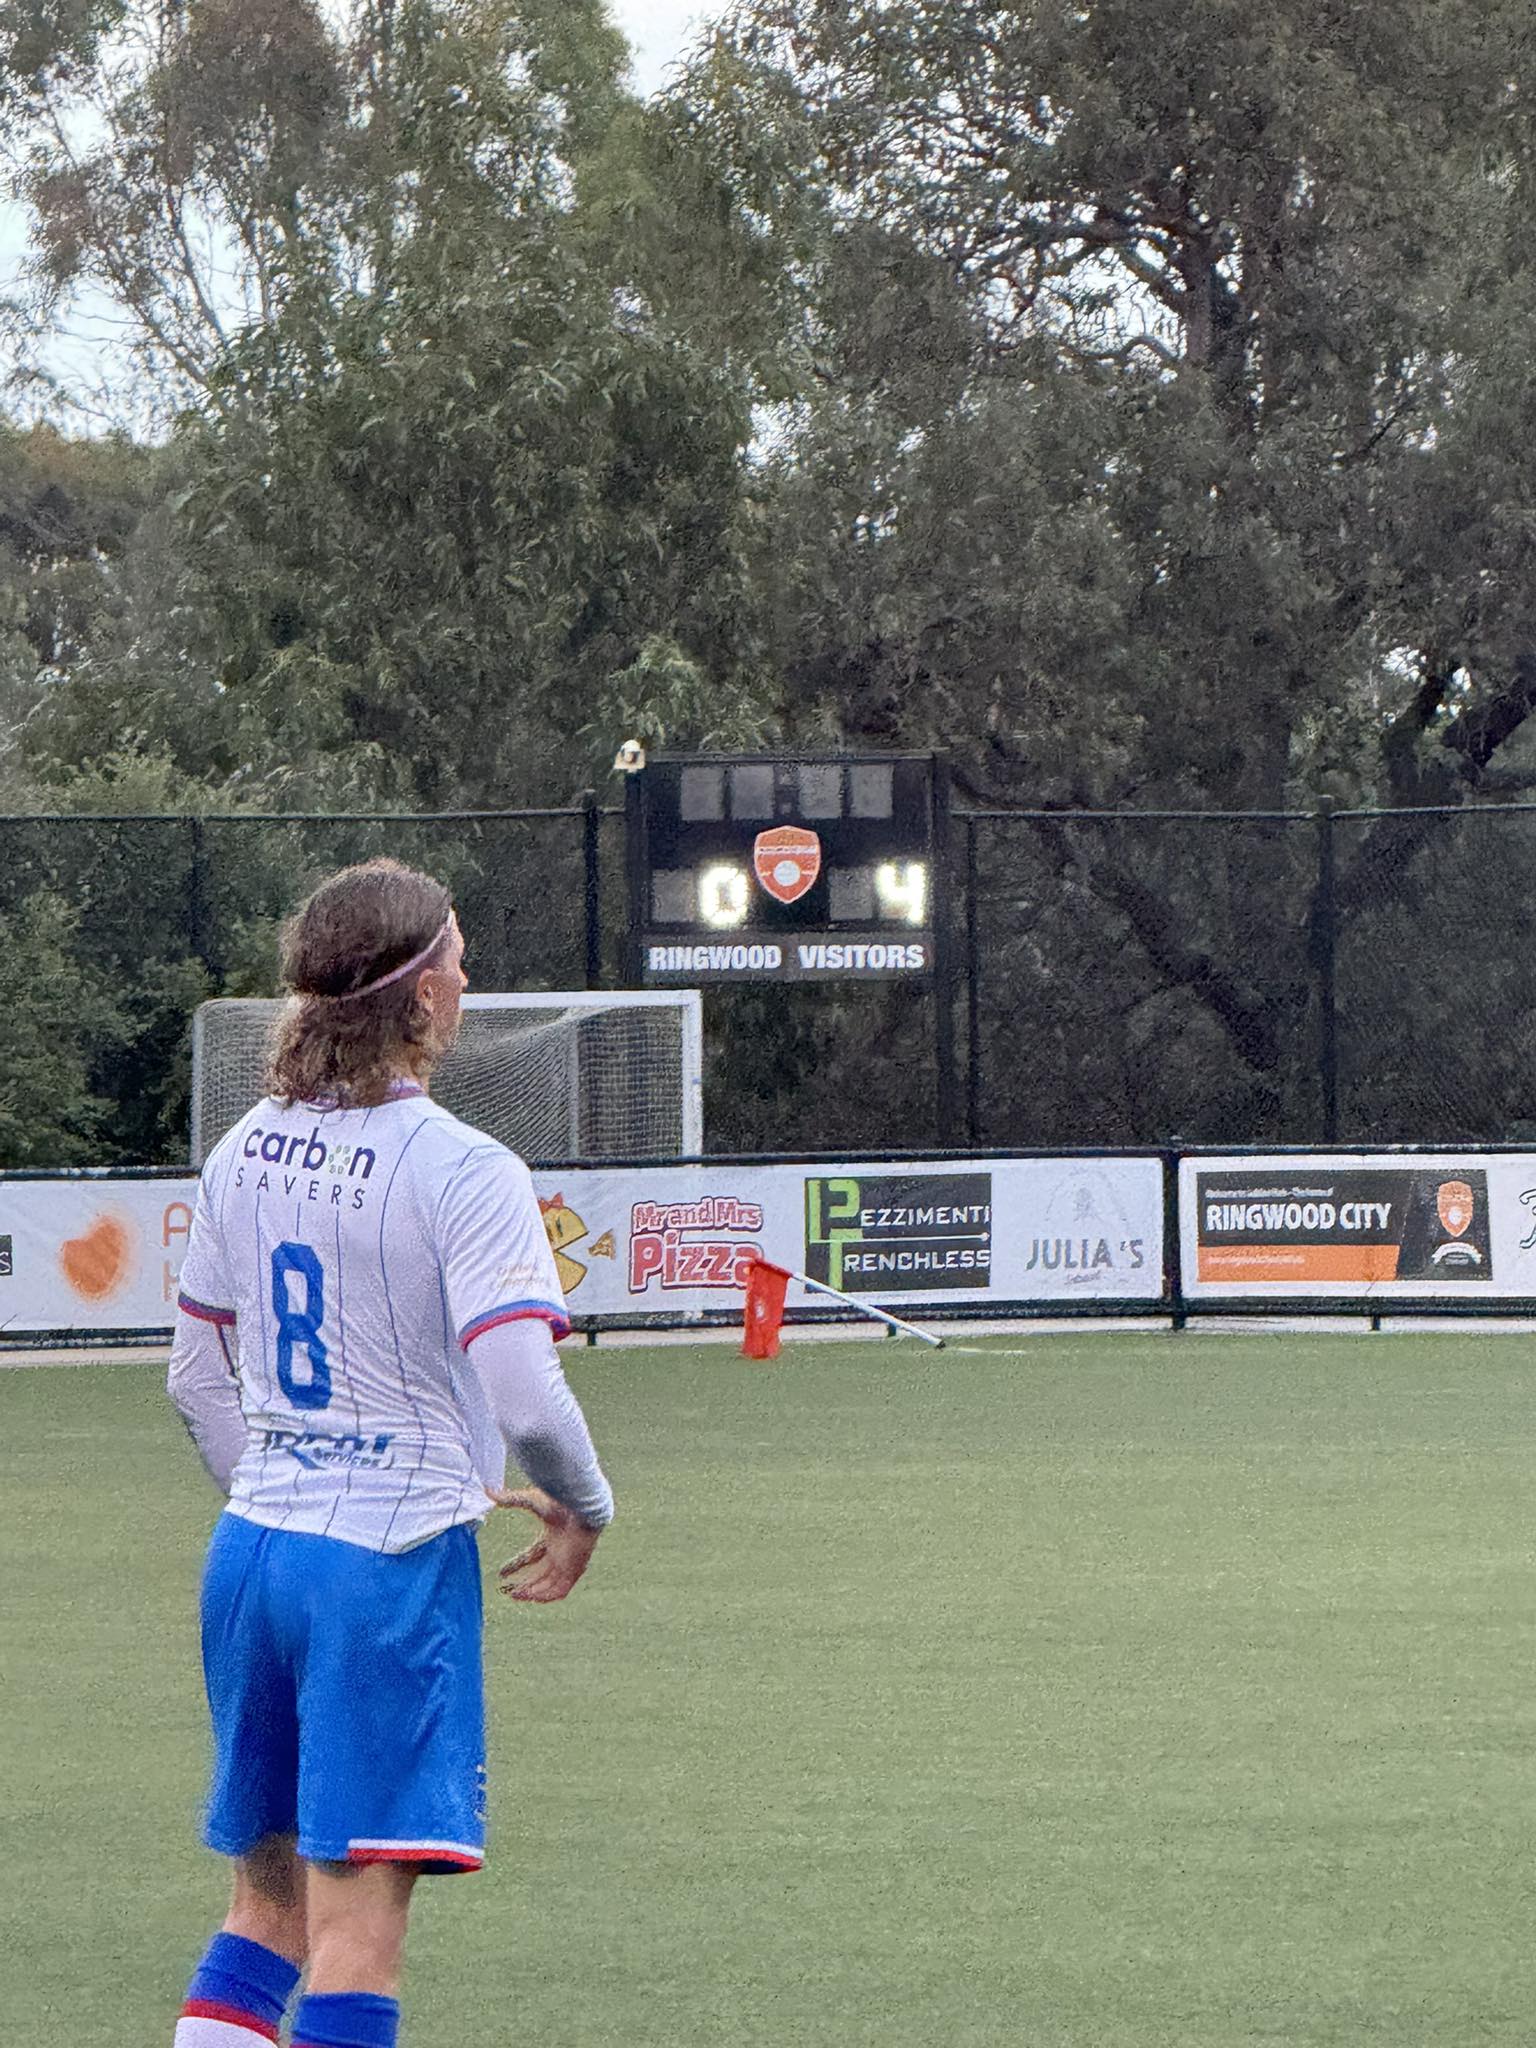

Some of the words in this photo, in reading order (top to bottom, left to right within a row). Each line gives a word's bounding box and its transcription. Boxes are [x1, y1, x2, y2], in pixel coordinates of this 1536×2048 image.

[700, 865, 749, 927] 0
[877, 863, 926, 927] 4
[649, 946, 782, 971] RINGWOOD
[797, 944, 925, 969] VISITORS
[235, 1166, 366, 1210] SAVERS
[1206, 1203, 1337, 1231] RINGWOOD
[1340, 1202, 1393, 1230] CITY
[632, 1231, 758, 1287] Pizza
[1025, 1238, 1145, 1271] JULIA'S
[271, 1240, 332, 1409] 8
